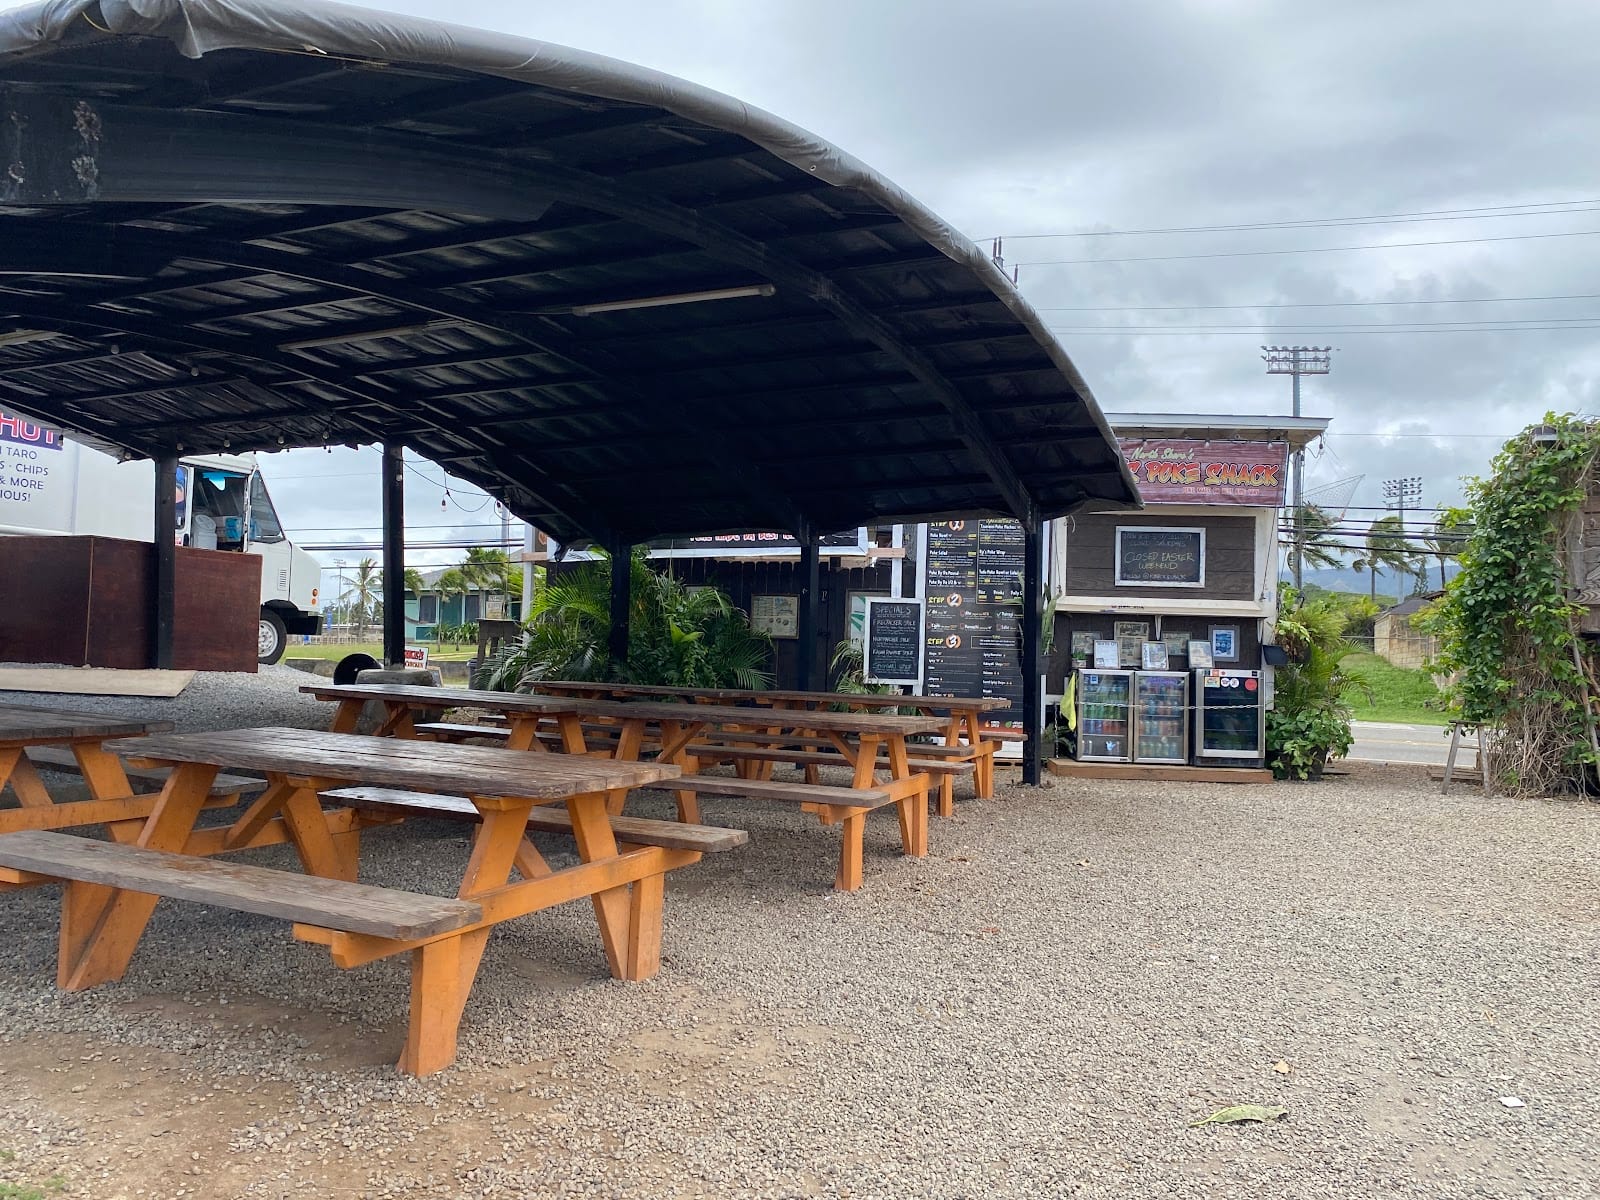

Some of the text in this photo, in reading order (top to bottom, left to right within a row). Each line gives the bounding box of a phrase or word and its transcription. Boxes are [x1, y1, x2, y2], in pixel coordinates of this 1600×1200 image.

[6, 446, 37, 460] TARO
[1131, 446, 1159, 460] North
[15, 463, 49, 476] CHIPS
[1145, 460, 1201, 485] POKE
[1203, 462, 1281, 487] SHACK
[10, 477, 44, 490] MORE
[1125, 552, 1195, 563] CLOSED EASTER
[1138, 562, 1178, 570] WEEKEND
[928, 596, 945, 604] STEP
[876, 605, 912, 615] SPECIALS
[927, 637, 944, 646] STEP
